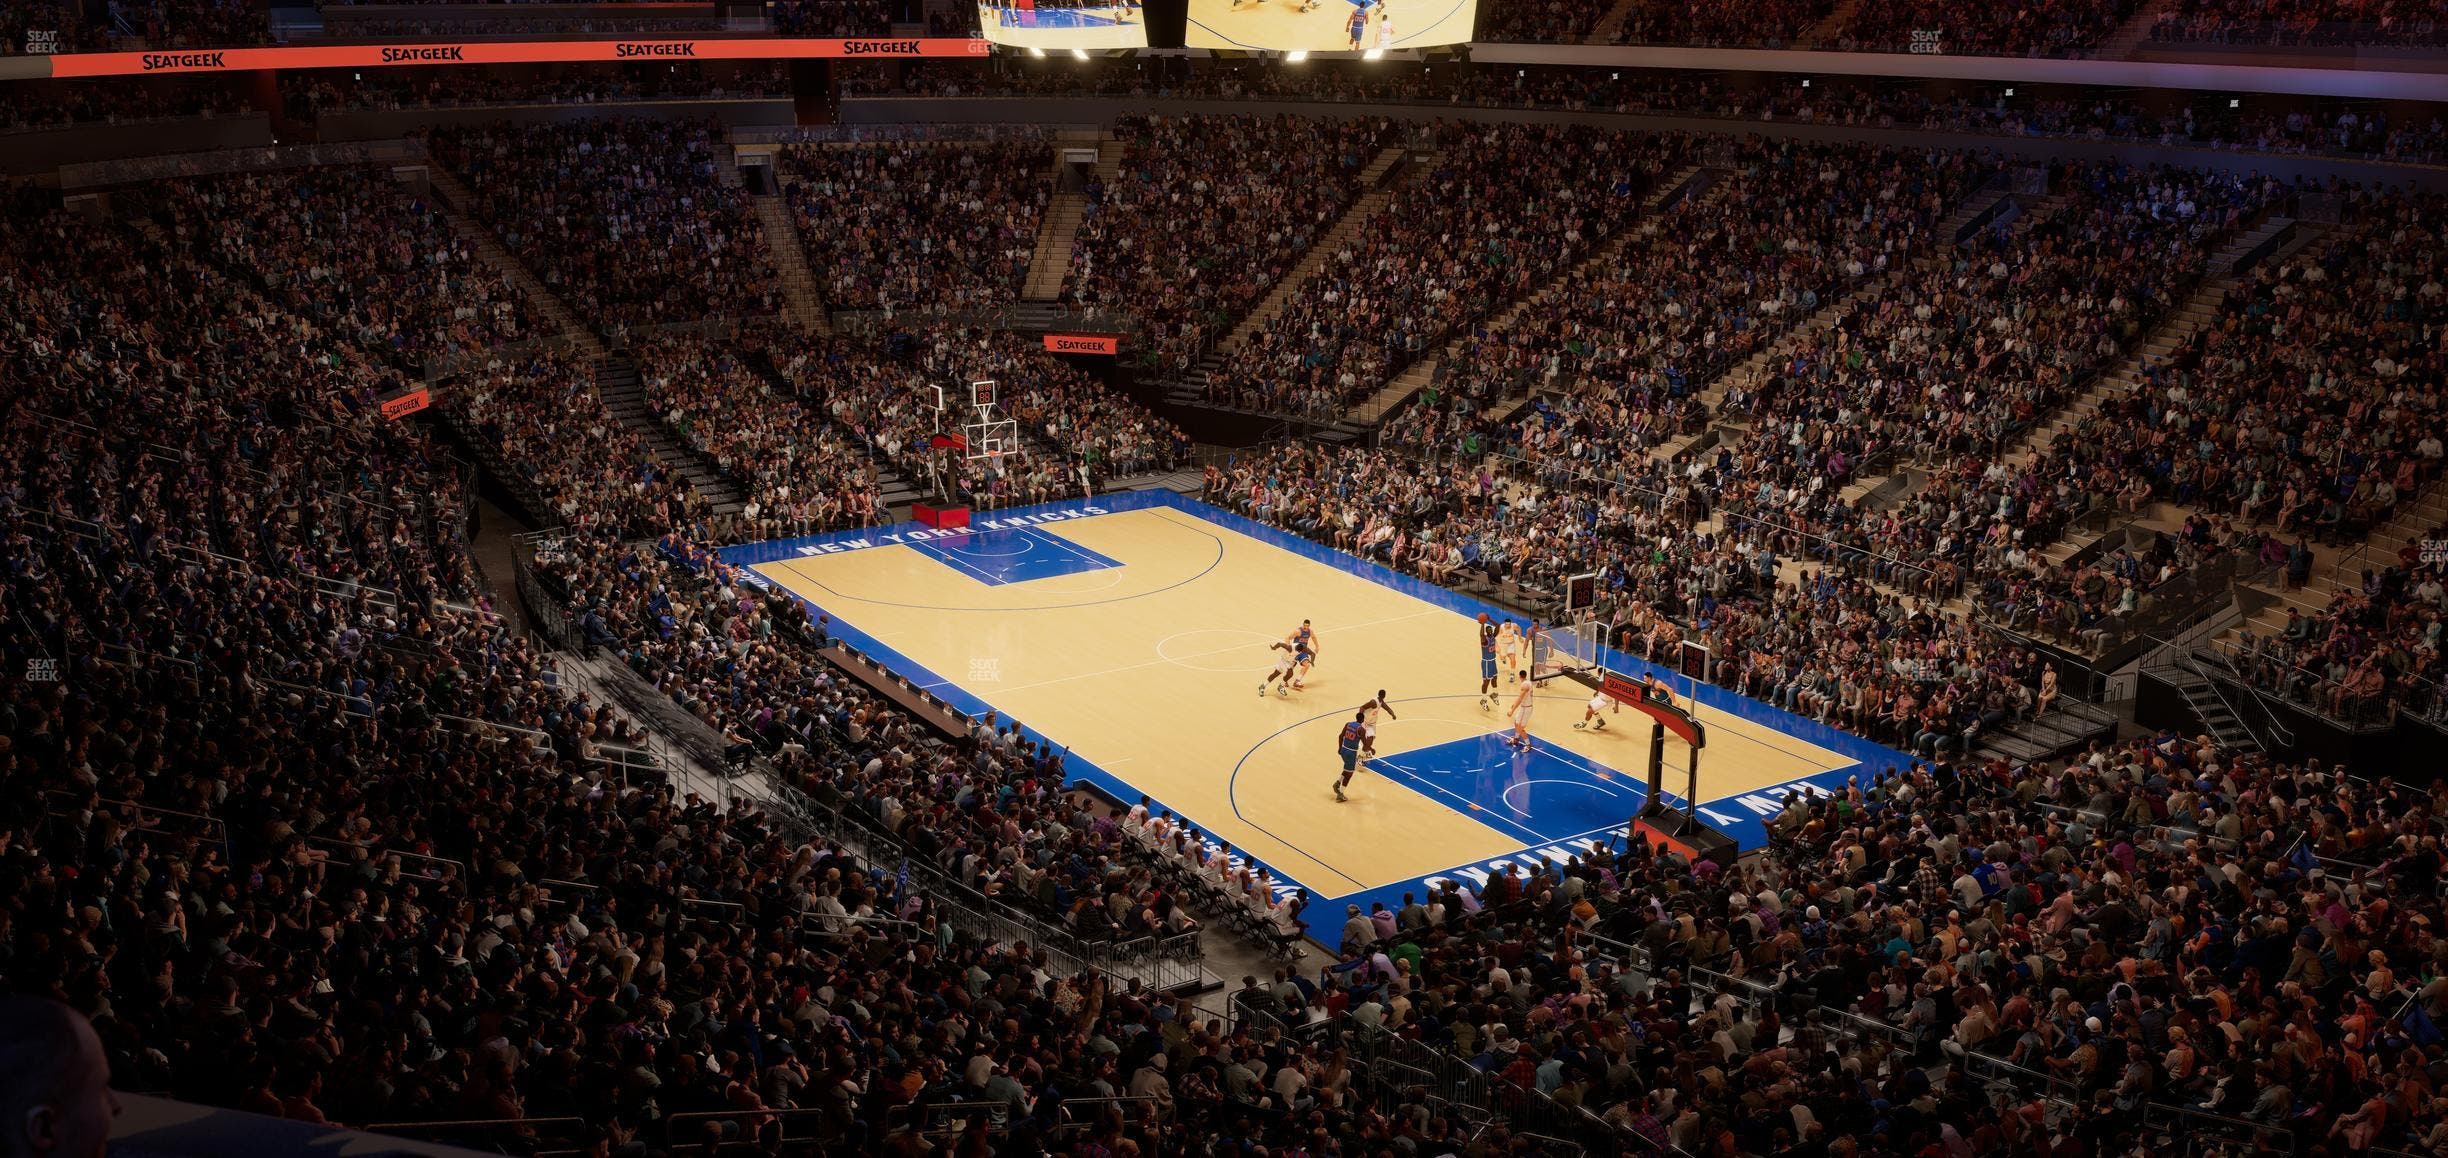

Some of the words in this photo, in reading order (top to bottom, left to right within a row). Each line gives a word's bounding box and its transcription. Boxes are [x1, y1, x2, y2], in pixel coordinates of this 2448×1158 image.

[382, 46, 463, 62] SEATGEEK
[617, 42, 695, 57] SEATGEEK
[844, 41, 921, 55] SEATGEEK
[142, 52, 225, 70] SEATGEEK
[1057, 339, 1106, 351] SEATGEEK
[389, 397, 420, 417] SEATGEEK
[797, 538, 872, 555] NEW
[981, 506, 1110, 528] KNICKS
[1608, 678, 1637, 697] SEATGEEK
